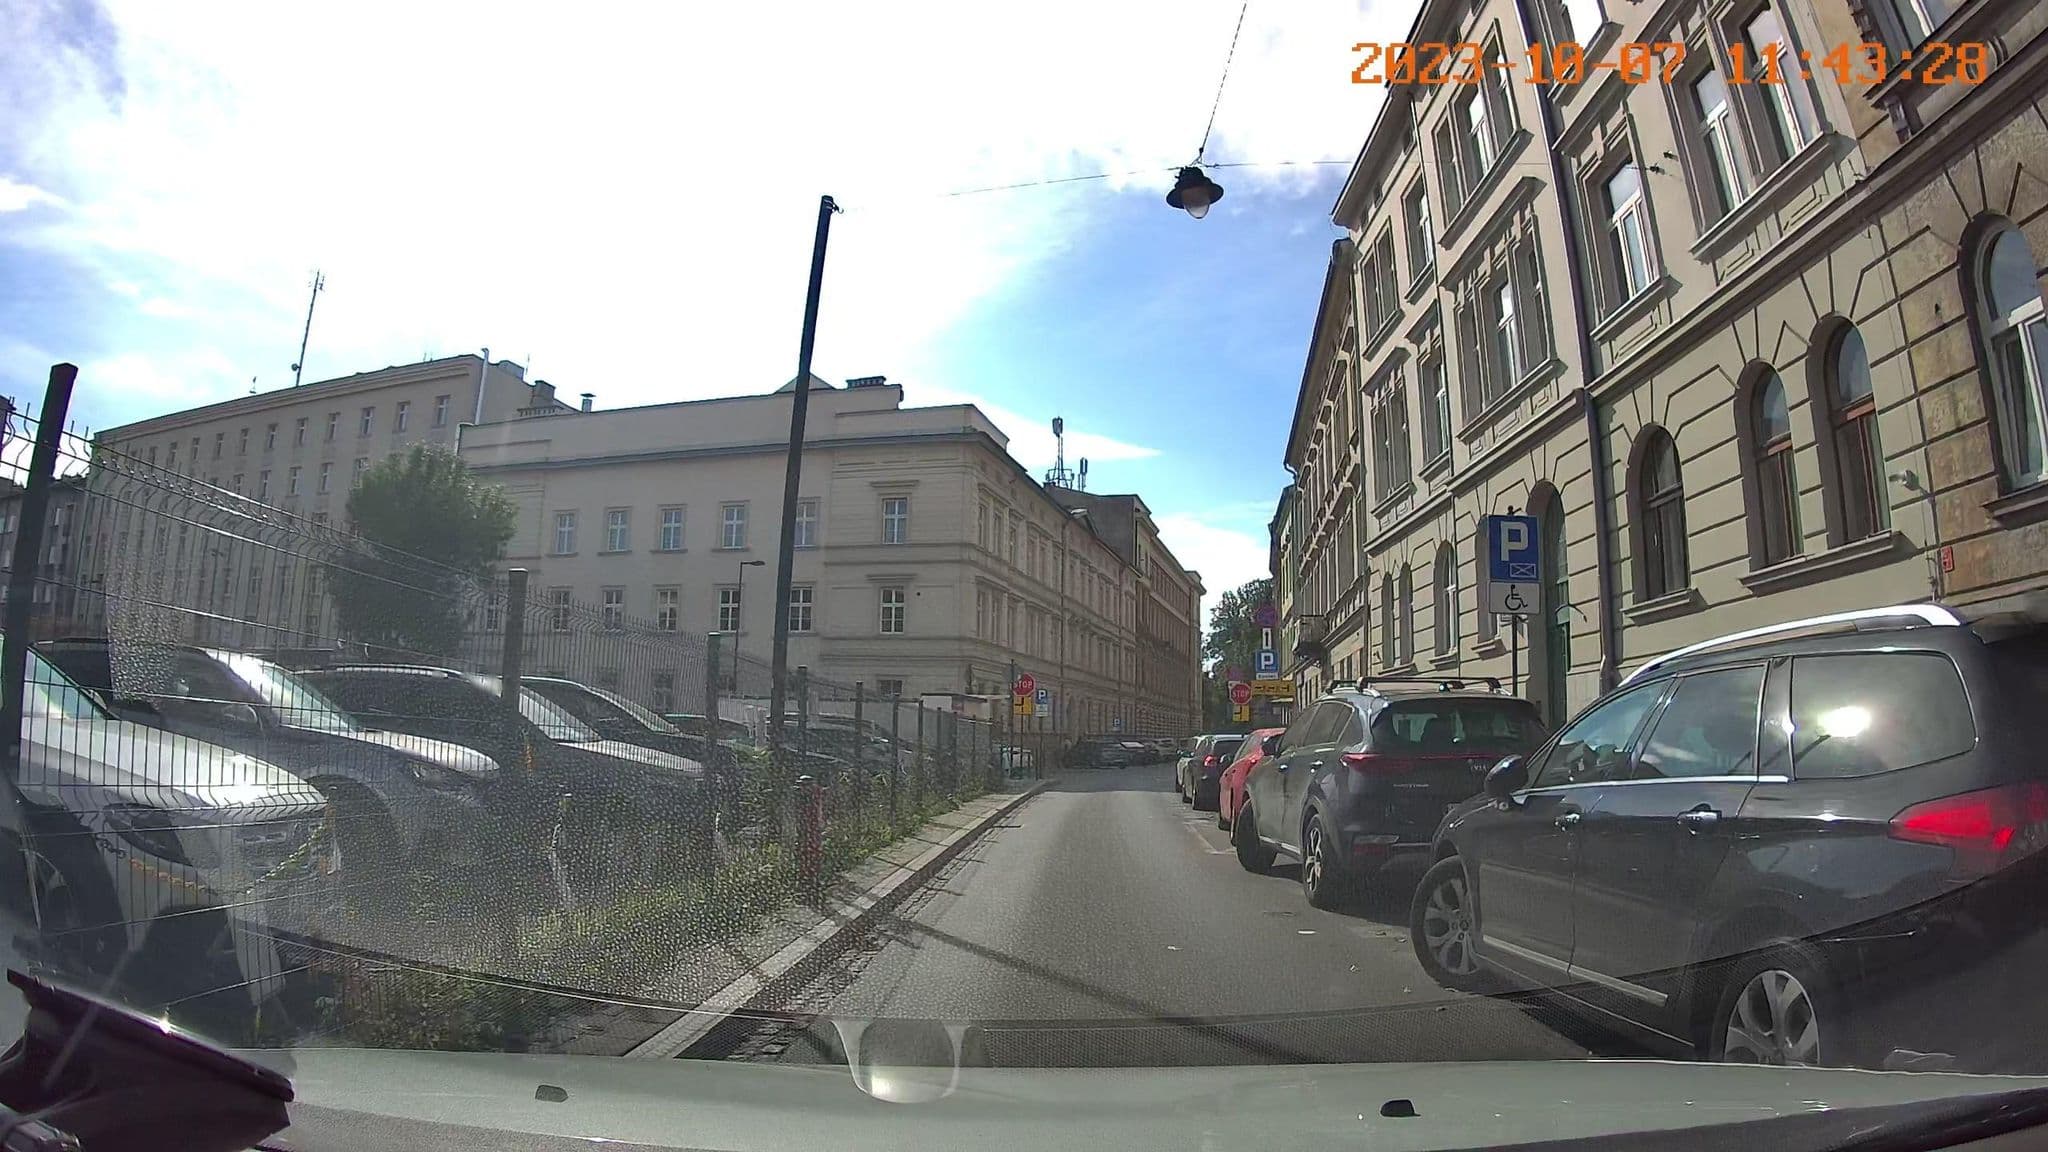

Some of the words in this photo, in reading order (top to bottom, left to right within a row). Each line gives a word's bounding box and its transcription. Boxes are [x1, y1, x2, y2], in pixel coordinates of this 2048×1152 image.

[1501, 521, 1529, 562] P
[1261, 652, 1274, 669] P
[1038, 690, 1046, 700] P
[1232, 690, 1250, 698] STOP
